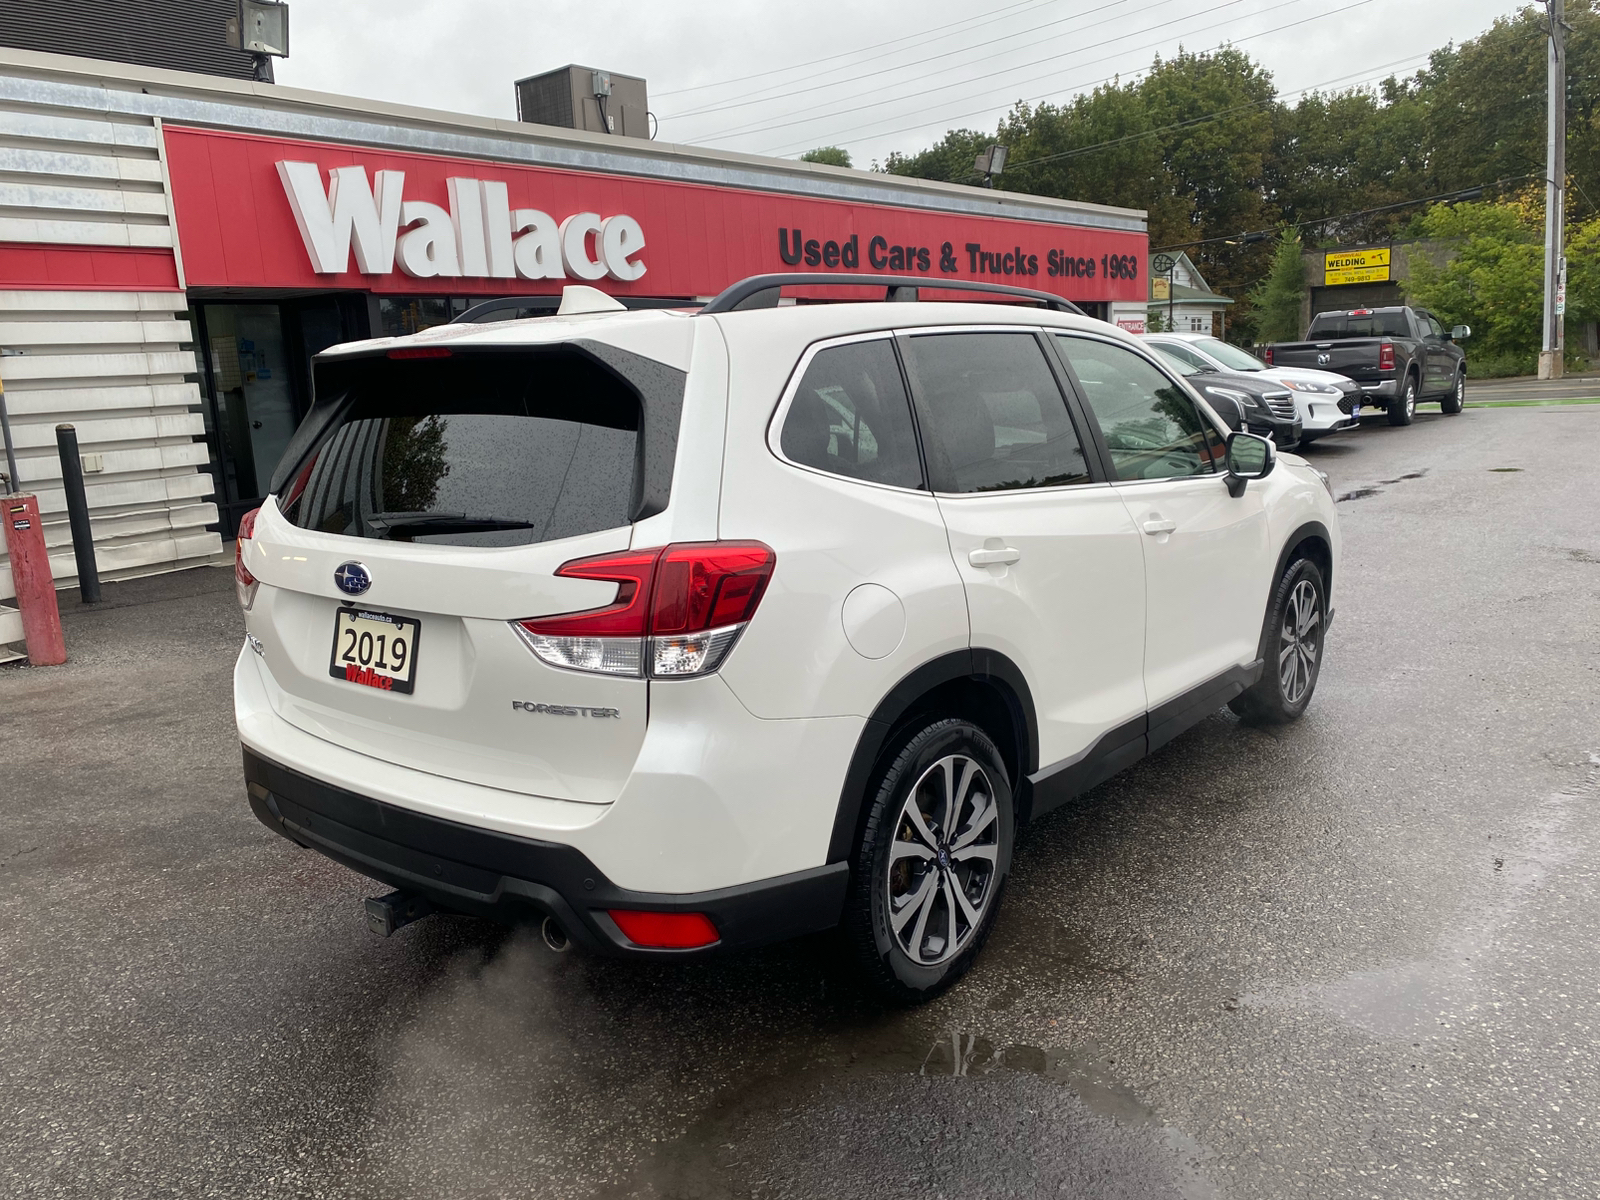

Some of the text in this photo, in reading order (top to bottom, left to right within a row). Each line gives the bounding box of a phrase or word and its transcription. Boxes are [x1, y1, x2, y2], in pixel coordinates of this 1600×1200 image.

[275, 160, 648, 281] Wallace
[778, 227, 1137, 280] Used Cars & Trucks Since 1963
[1328, 258, 1366, 268] WELDING
[1119, 322, 1144, 330] ENTRANCE
[358, 611, 393, 623] wallaceauto.ca
[342, 628, 407, 672] 2019
[345, 663, 393, 691] Wallace
[511, 700, 621, 719] FORESTER
